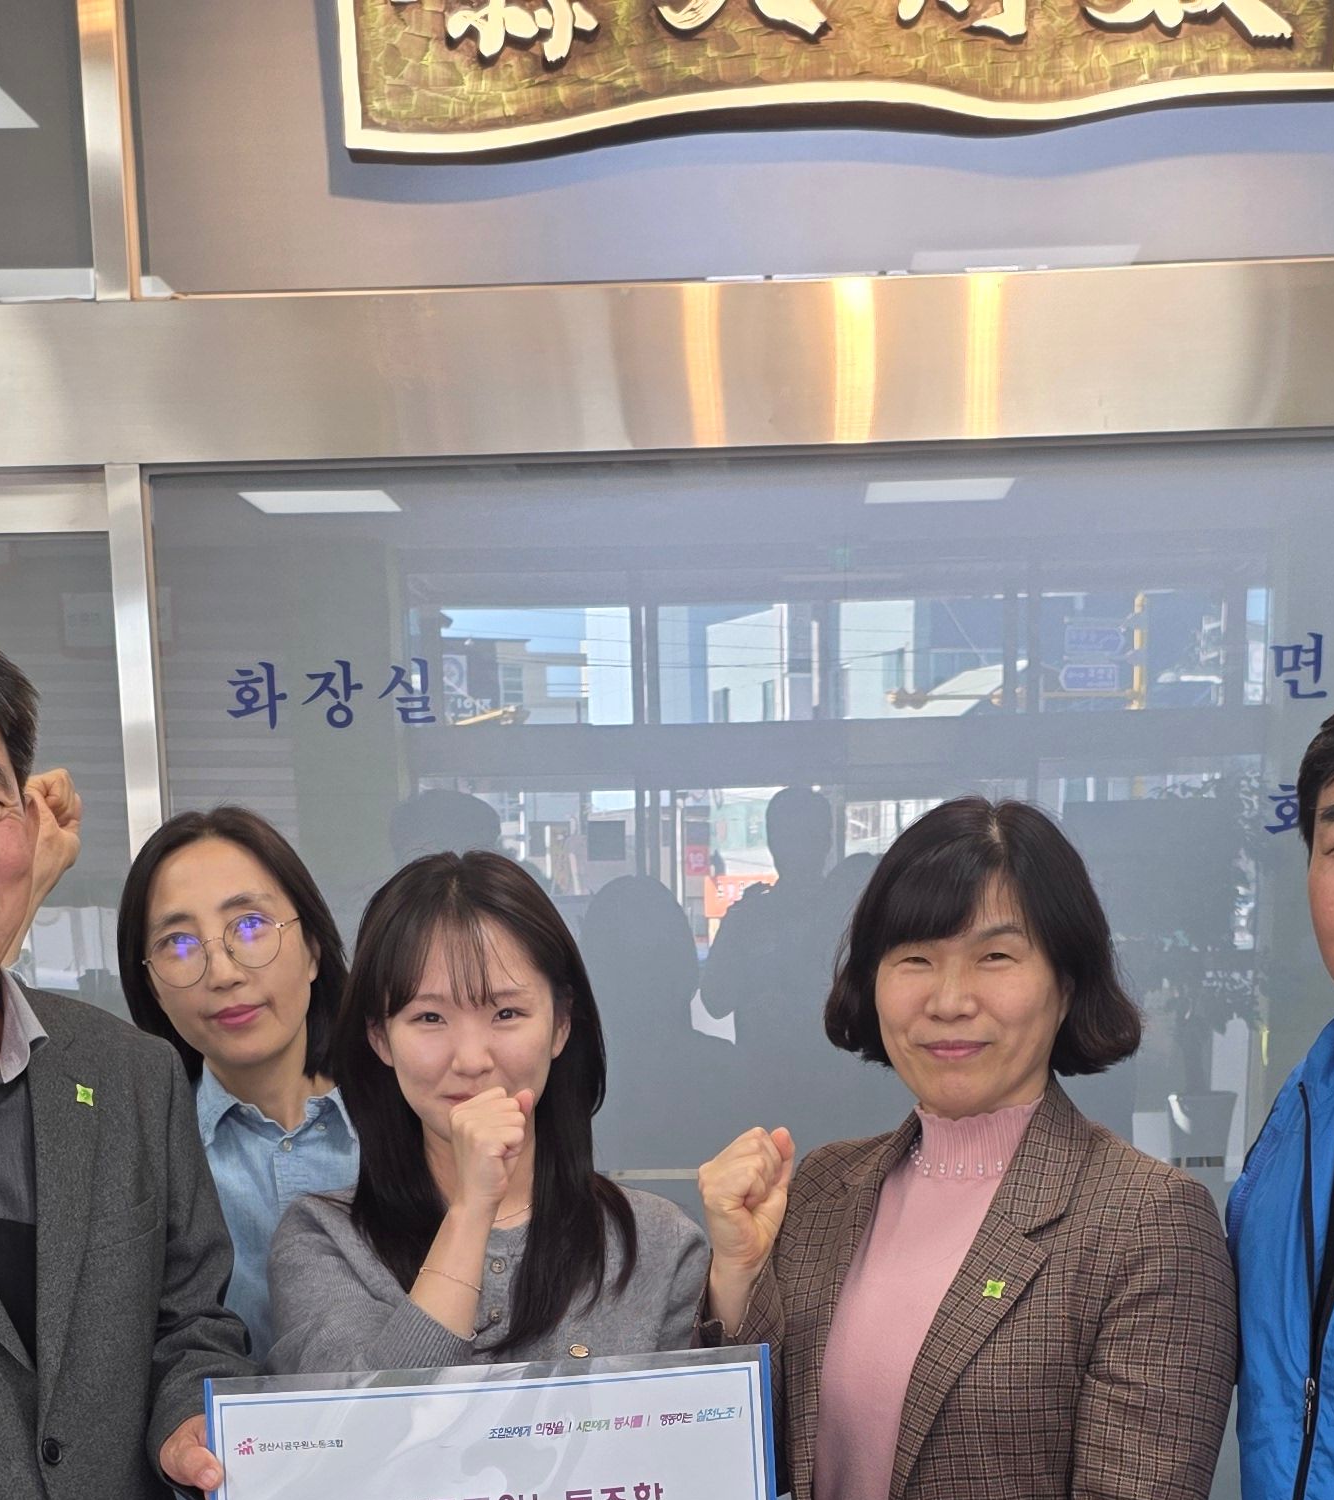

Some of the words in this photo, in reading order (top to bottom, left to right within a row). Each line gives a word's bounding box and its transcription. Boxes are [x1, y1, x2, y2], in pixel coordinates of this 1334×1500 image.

[226, 658, 436, 730] 화장실
[534, 1420, 565, 1436] 희망을
[696, 1406, 736, 1422] 실천노조
[258, 1439, 344, 1453] 경산시공무원노동조합
